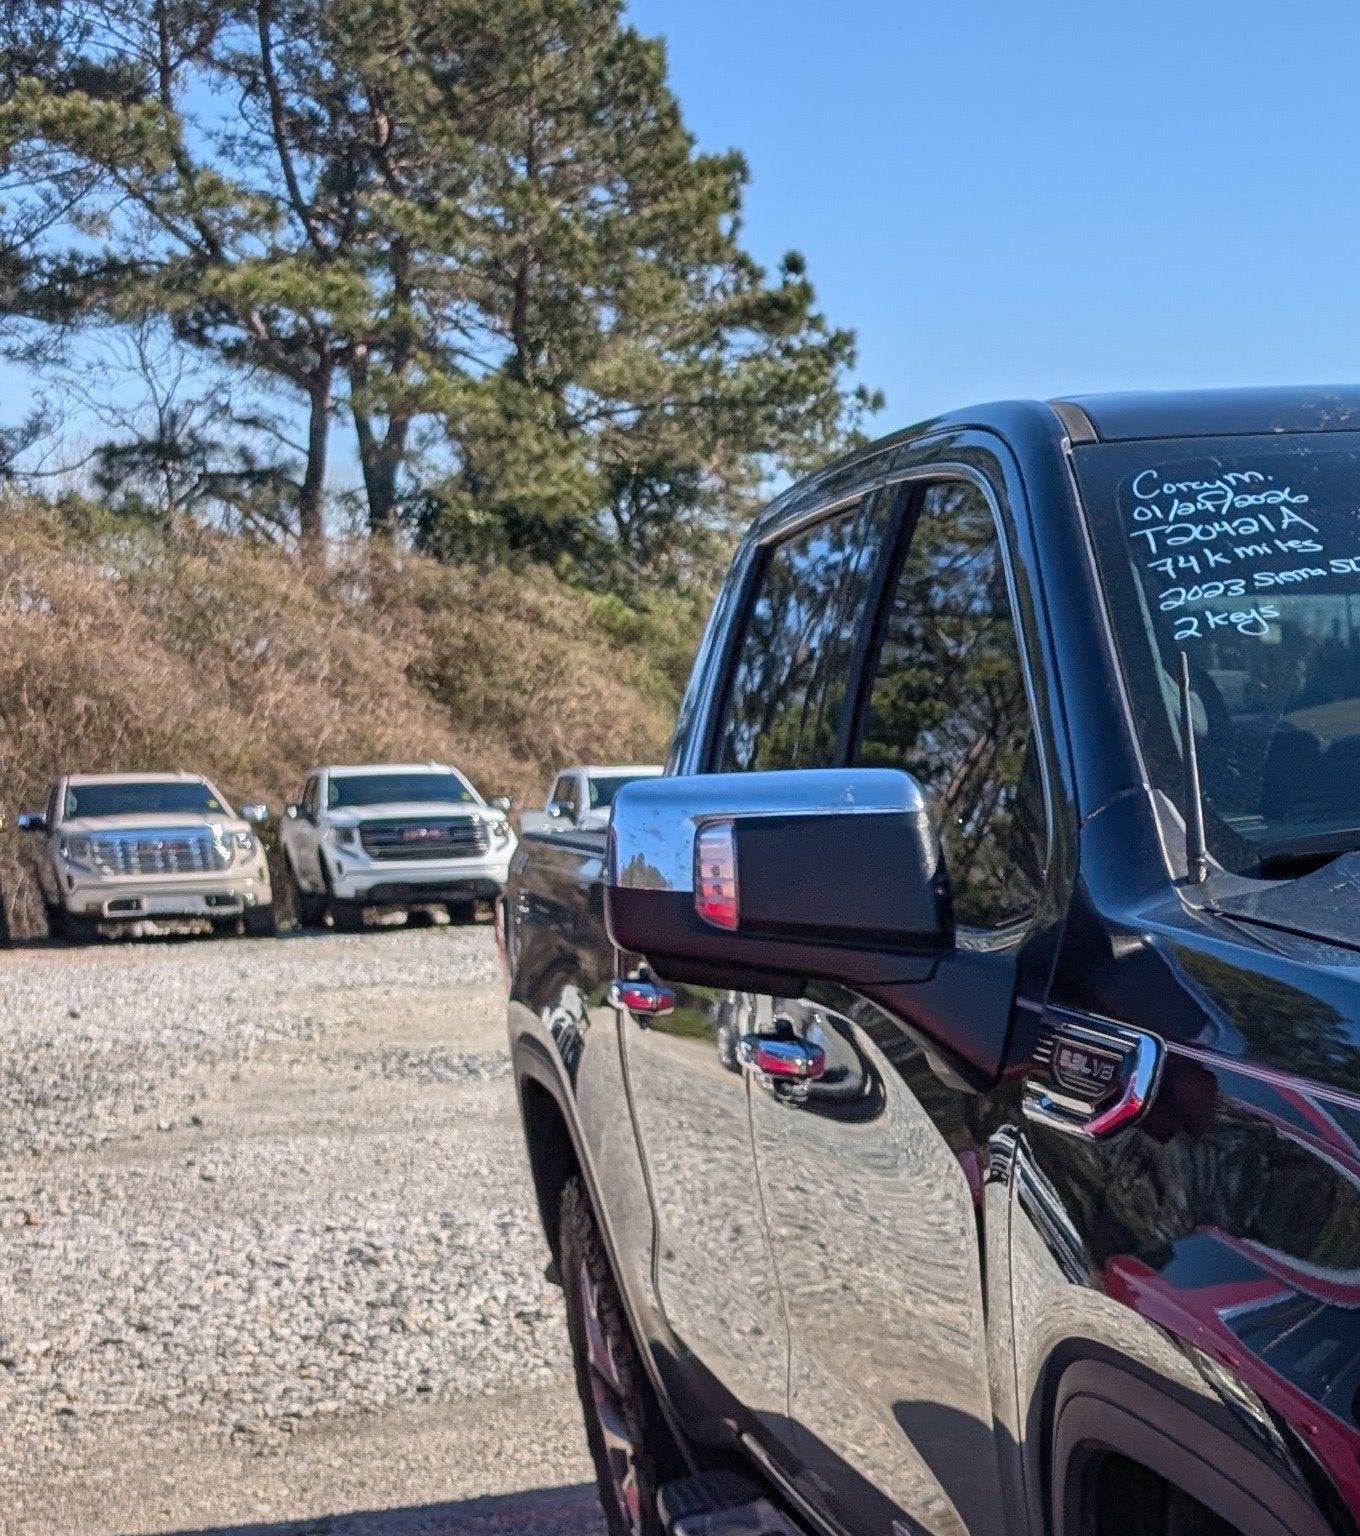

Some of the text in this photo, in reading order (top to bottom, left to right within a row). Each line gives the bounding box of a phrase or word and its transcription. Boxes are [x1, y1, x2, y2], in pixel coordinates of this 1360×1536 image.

[1159, 578, 1247, 611] 2023
[1174, 604, 1280, 641] 2 keys
